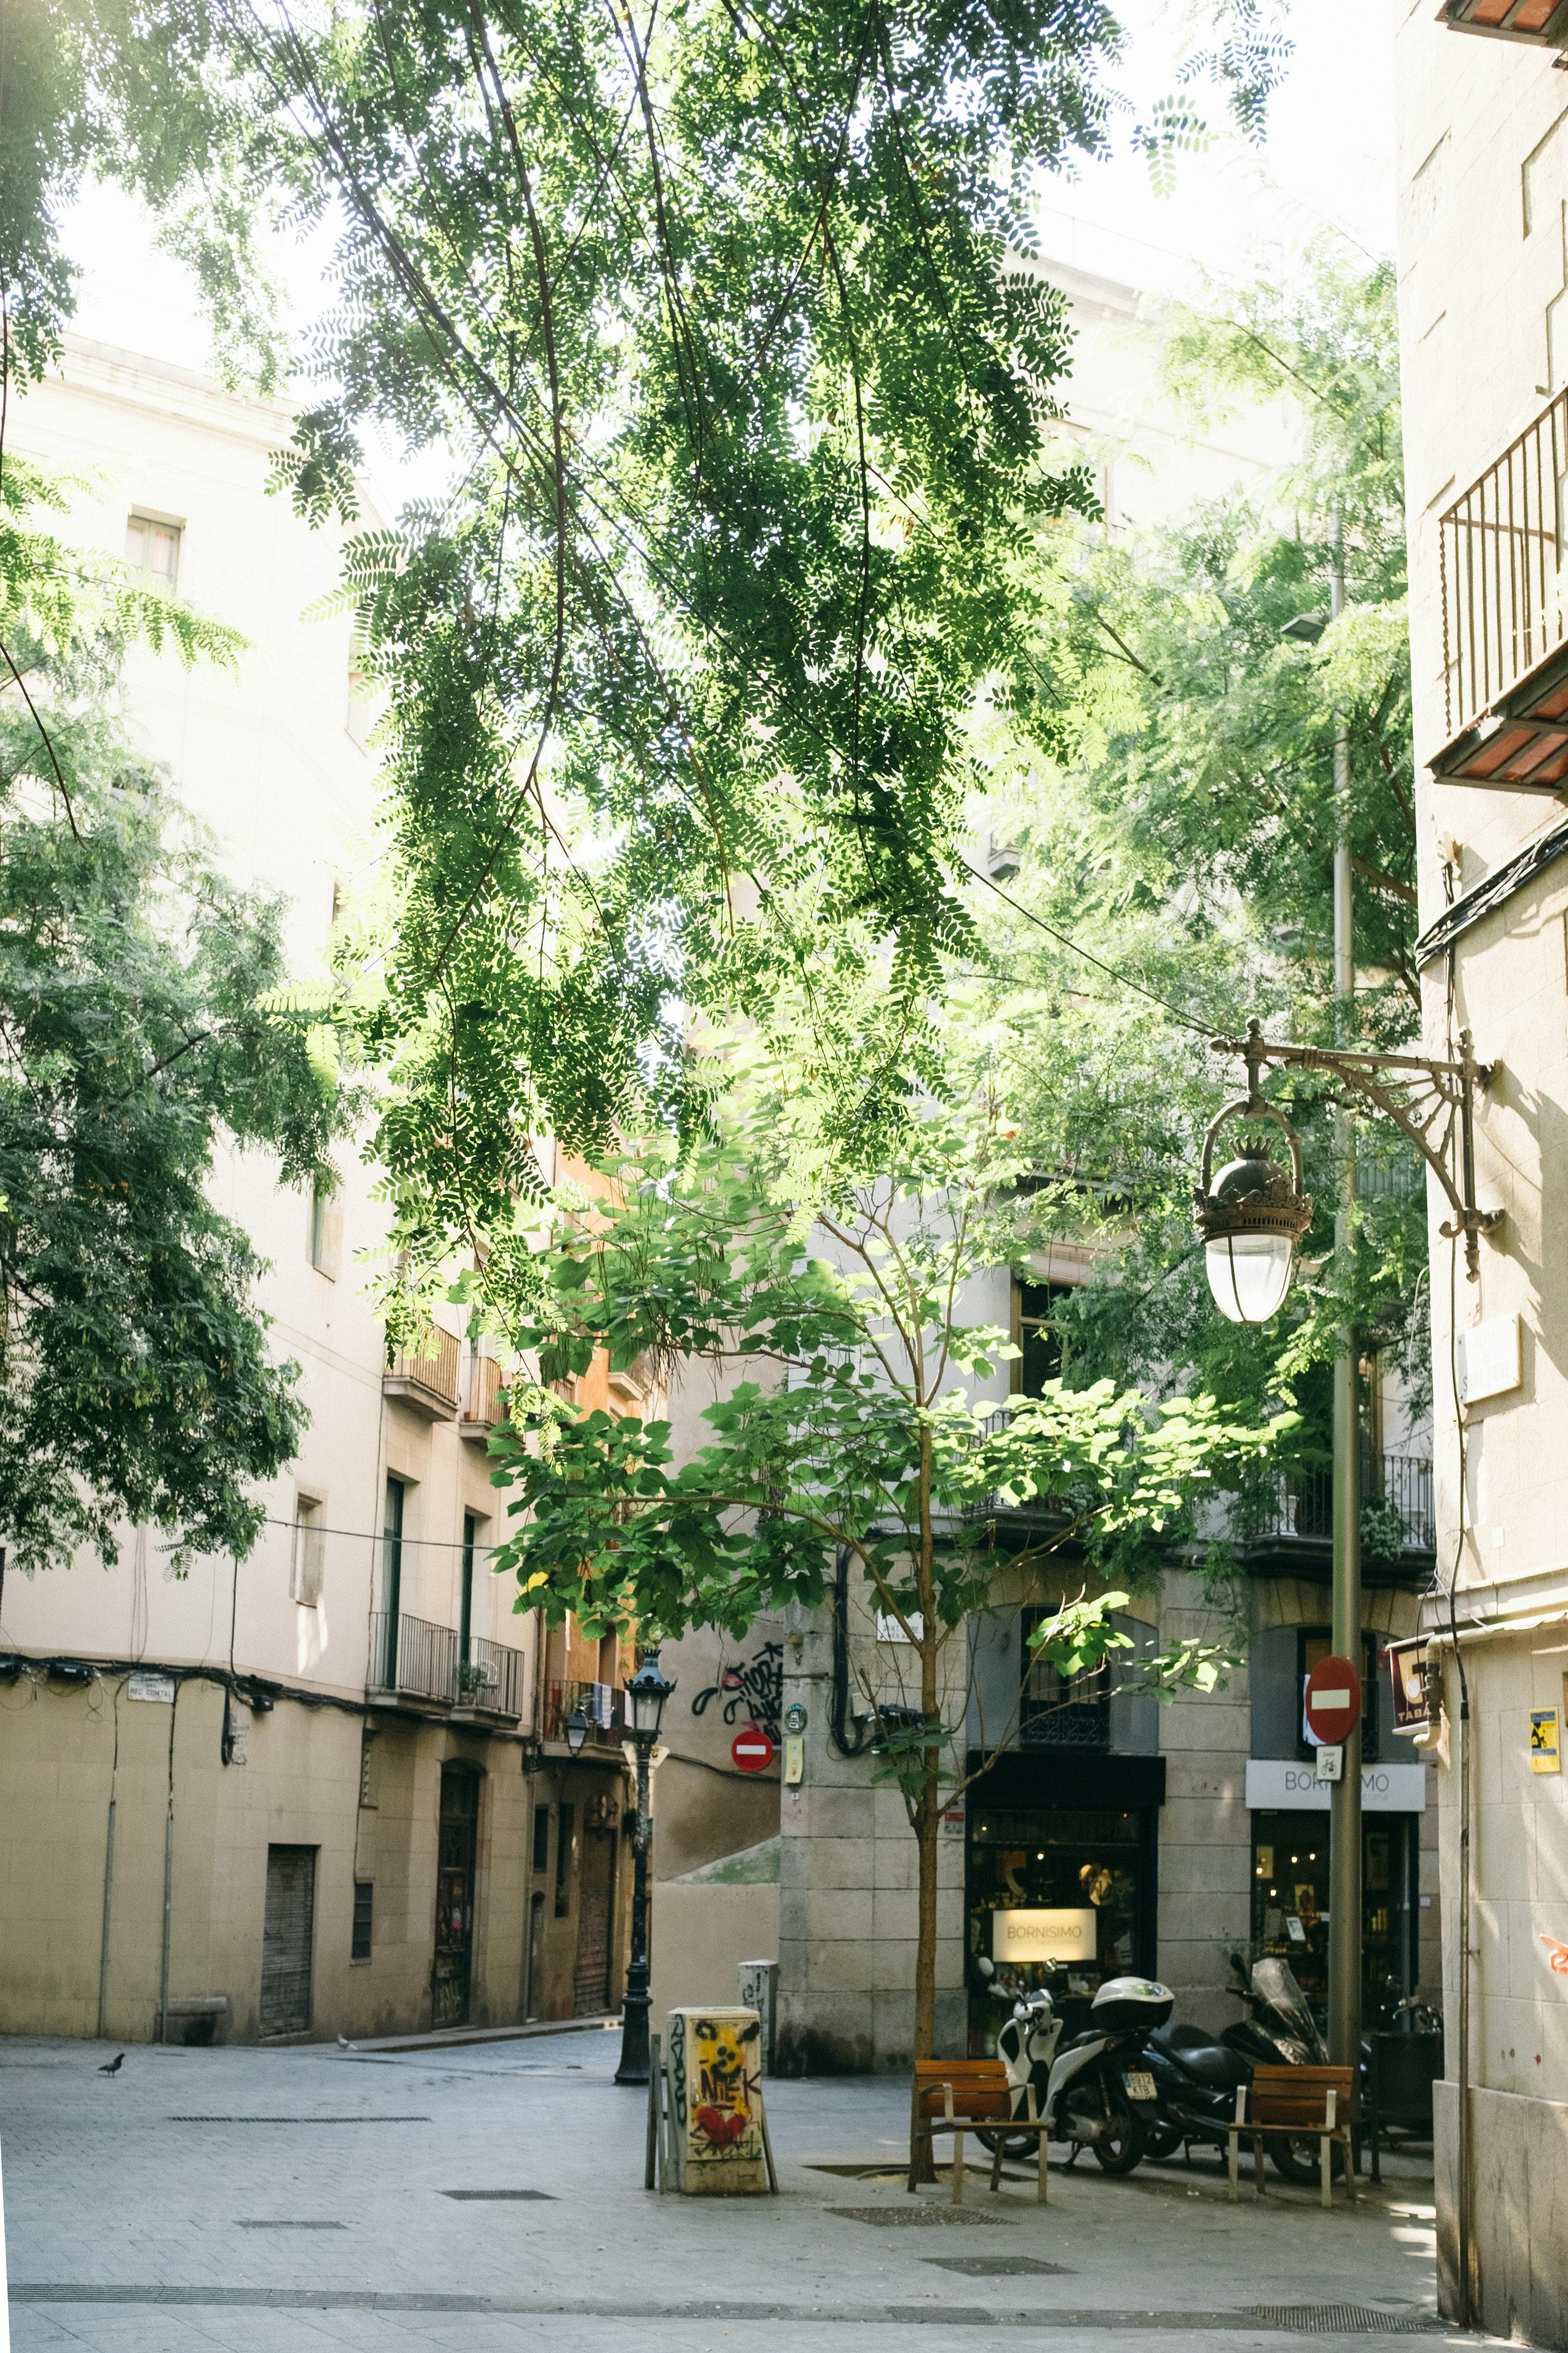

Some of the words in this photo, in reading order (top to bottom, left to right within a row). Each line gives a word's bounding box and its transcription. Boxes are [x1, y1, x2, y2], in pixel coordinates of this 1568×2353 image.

[1463, 1369, 1484, 1392] SANT
[1398, 1708, 1428, 1722] TABA
[1285, 1771, 1389, 1793] BORMO
[1007, 1926, 1082, 1938] BORNISIMO
